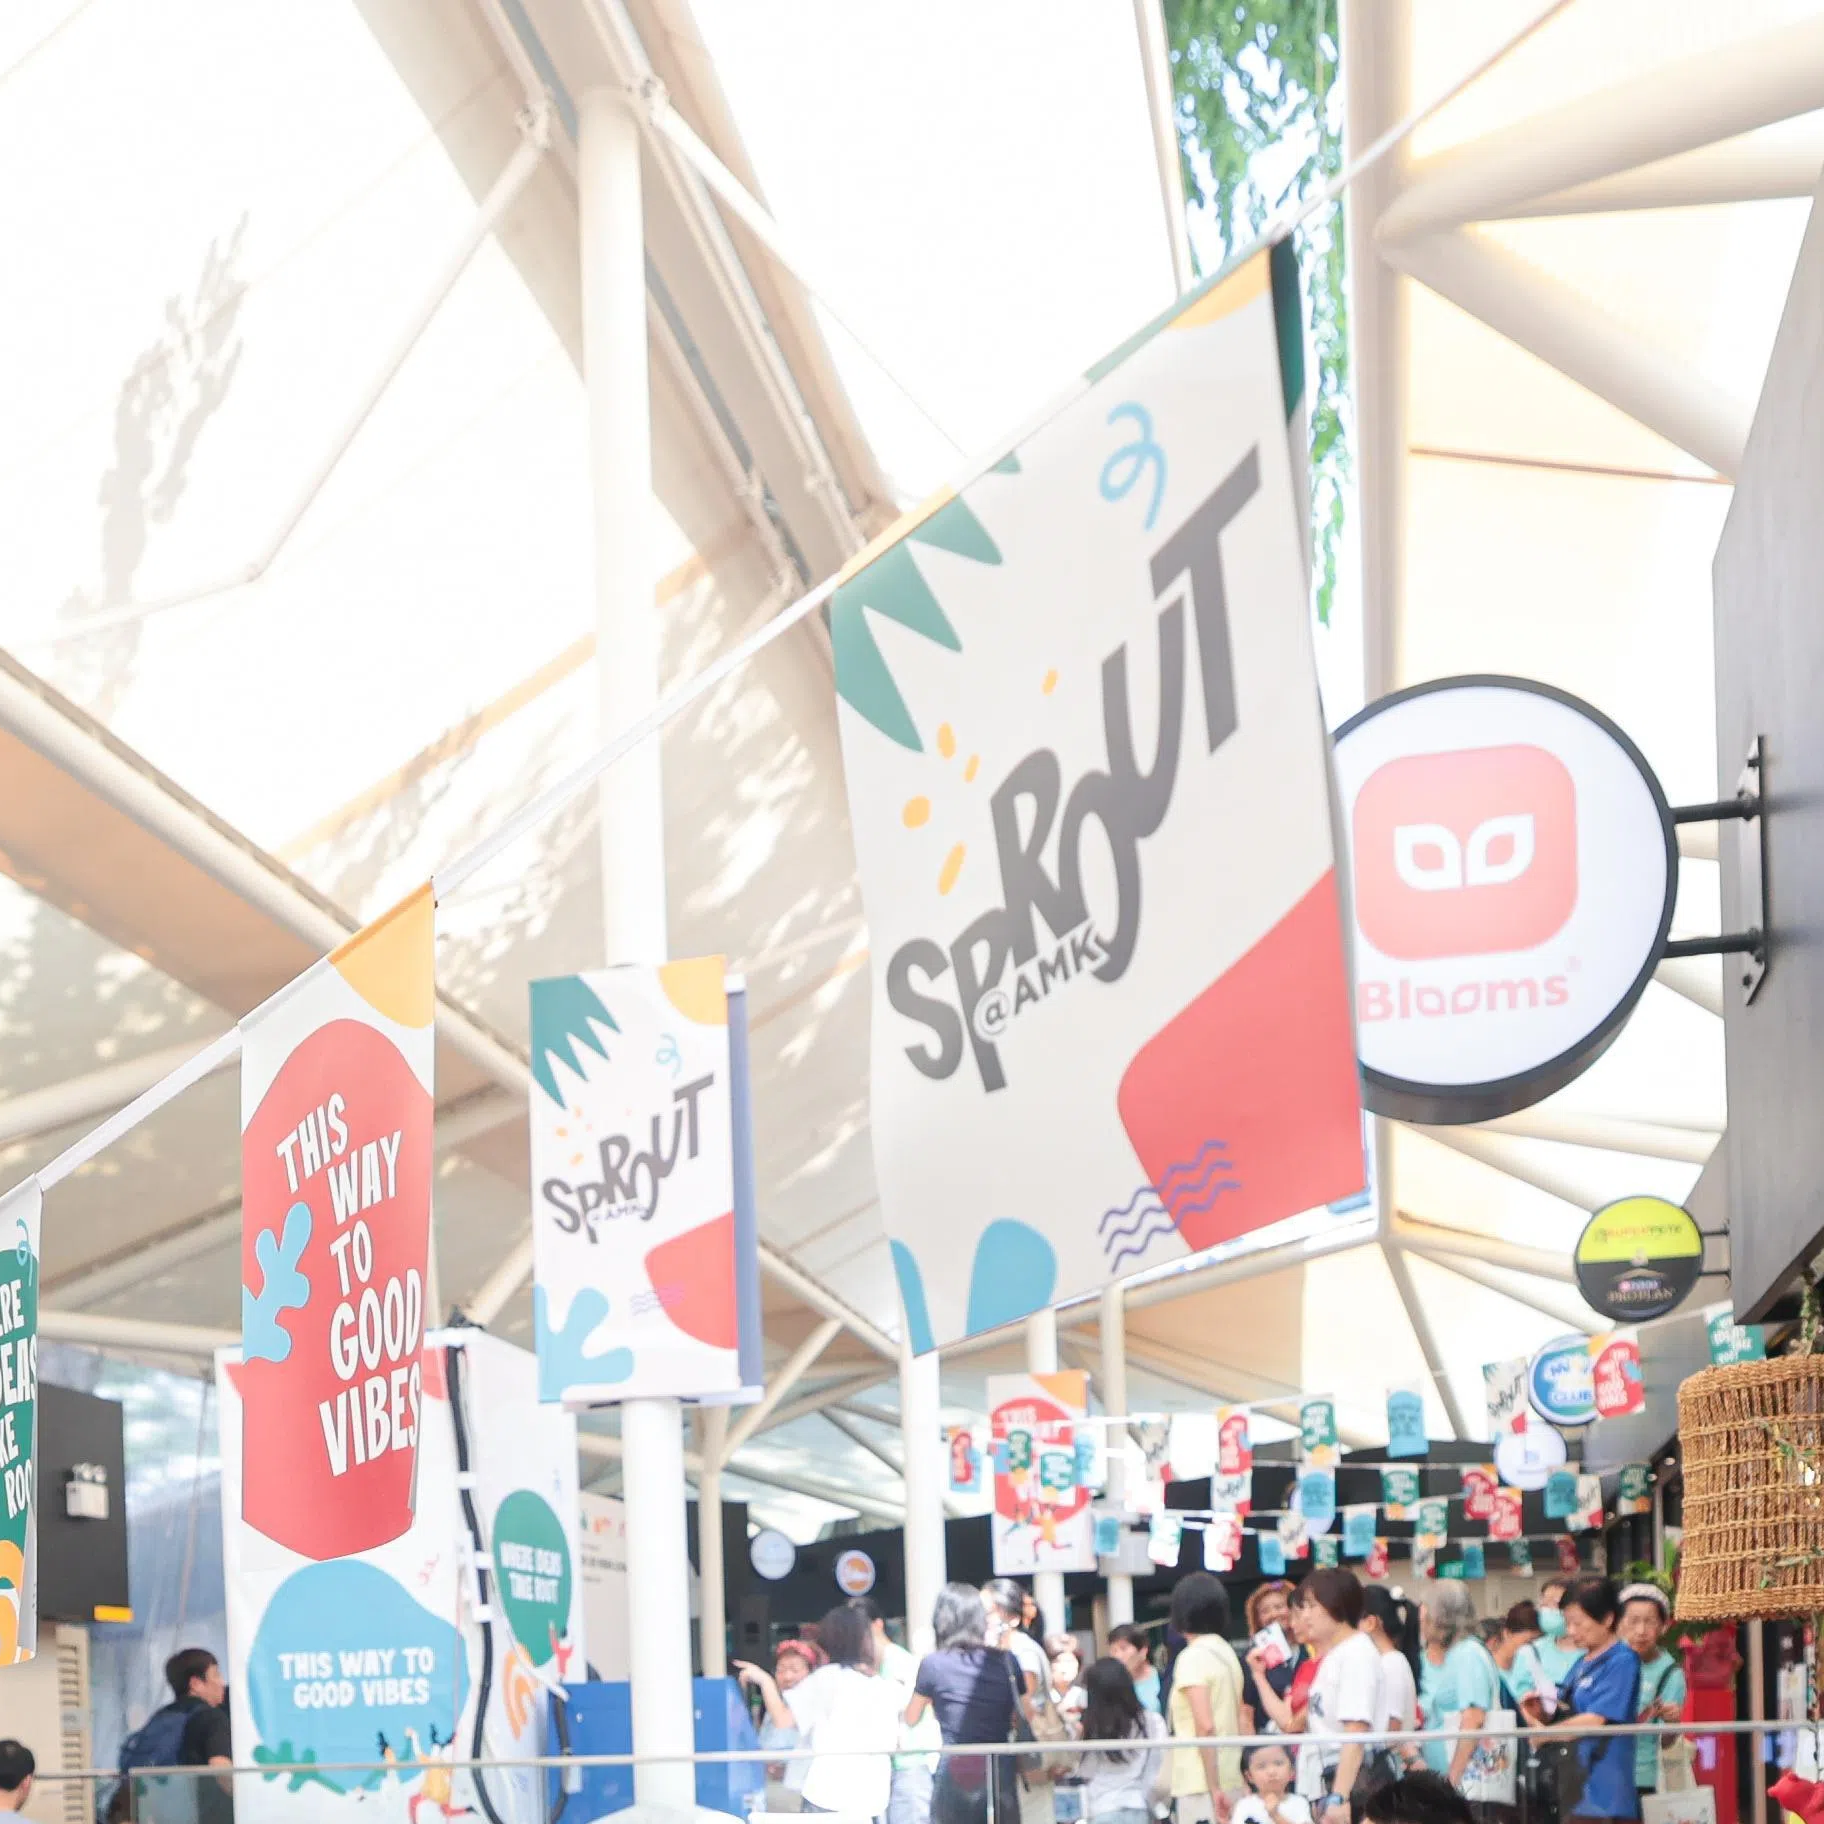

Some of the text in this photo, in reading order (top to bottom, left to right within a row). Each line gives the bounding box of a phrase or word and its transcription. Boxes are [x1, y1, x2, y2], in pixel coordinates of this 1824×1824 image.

[886, 442, 1263, 1093] SPROUT
[277, 1092, 349, 1194] THIS
[326, 1131, 402, 1227] WAY
[543, 1074, 715, 1244] SPROUT
[329, 1221, 372, 1300] TO
[329, 1267, 422, 1382] GOOD
[319, 1367, 422, 1477] VIBES
[278, 1647, 435, 1678] THIS WAY TO
[293, 1677, 430, 1709] GOOD VIBES
